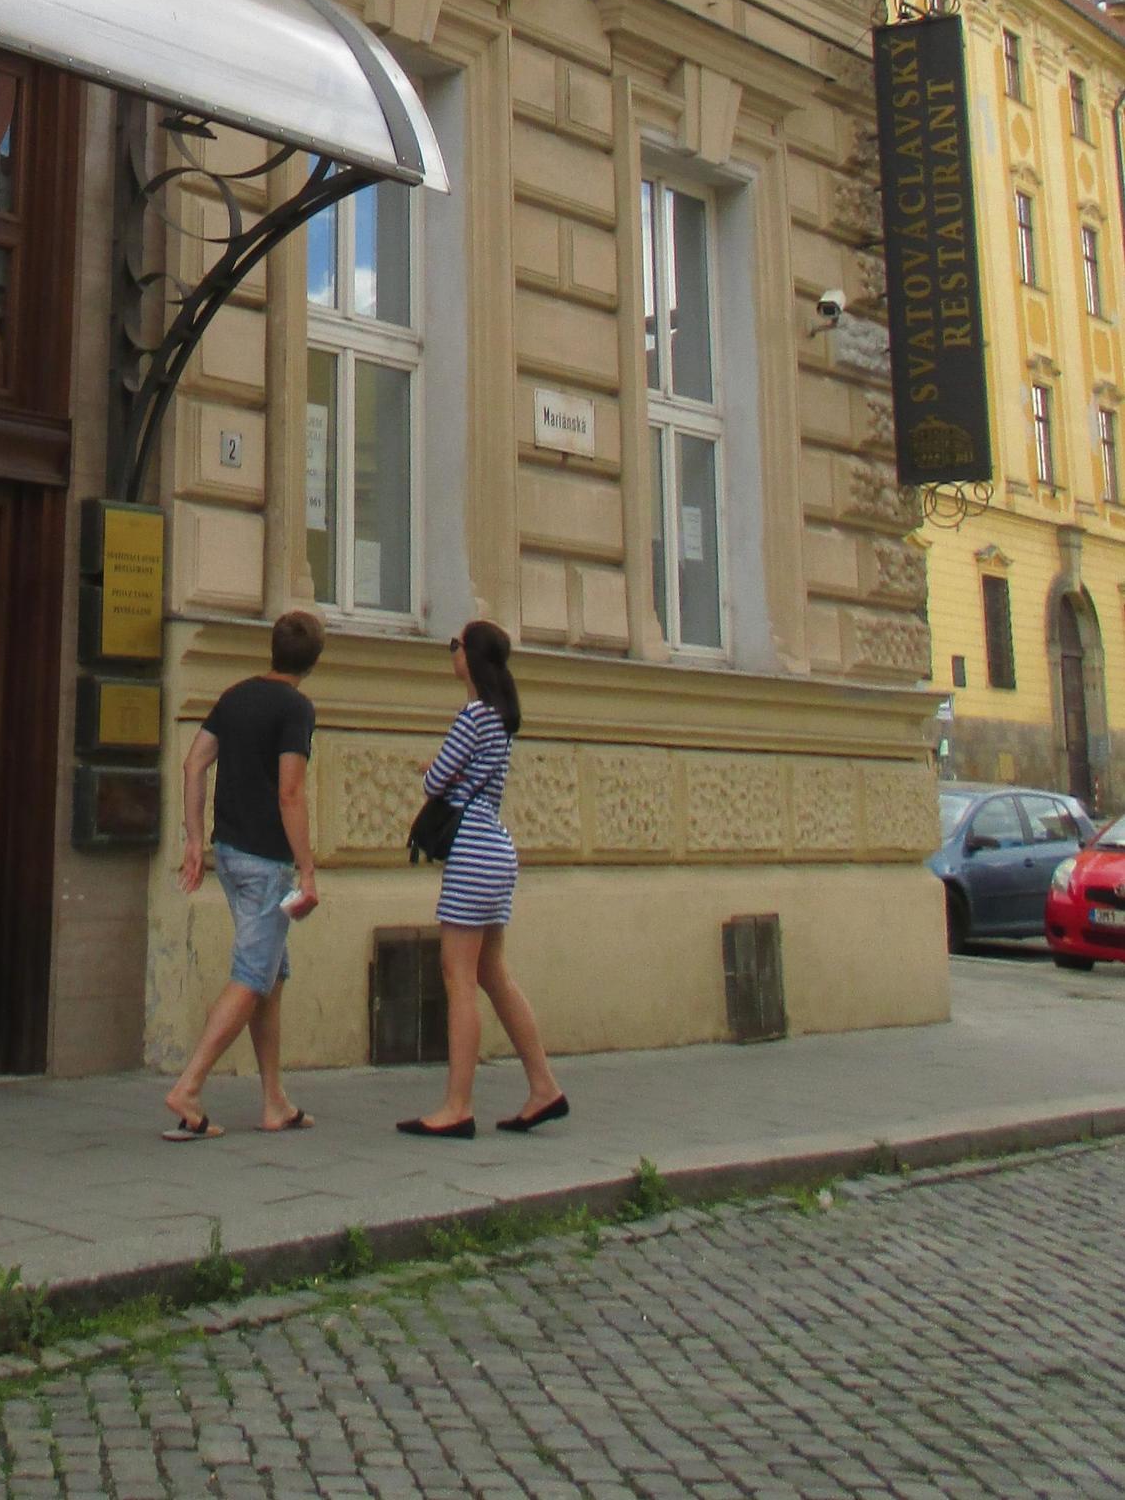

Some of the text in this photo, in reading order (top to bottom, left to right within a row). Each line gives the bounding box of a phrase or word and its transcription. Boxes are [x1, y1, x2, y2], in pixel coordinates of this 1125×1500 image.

[884, 34, 939, 404] SVATOVÁCLAVSKÝ
[926, 78, 972, 348] RESTAURANT
[228, 439, 236, 461] 2
